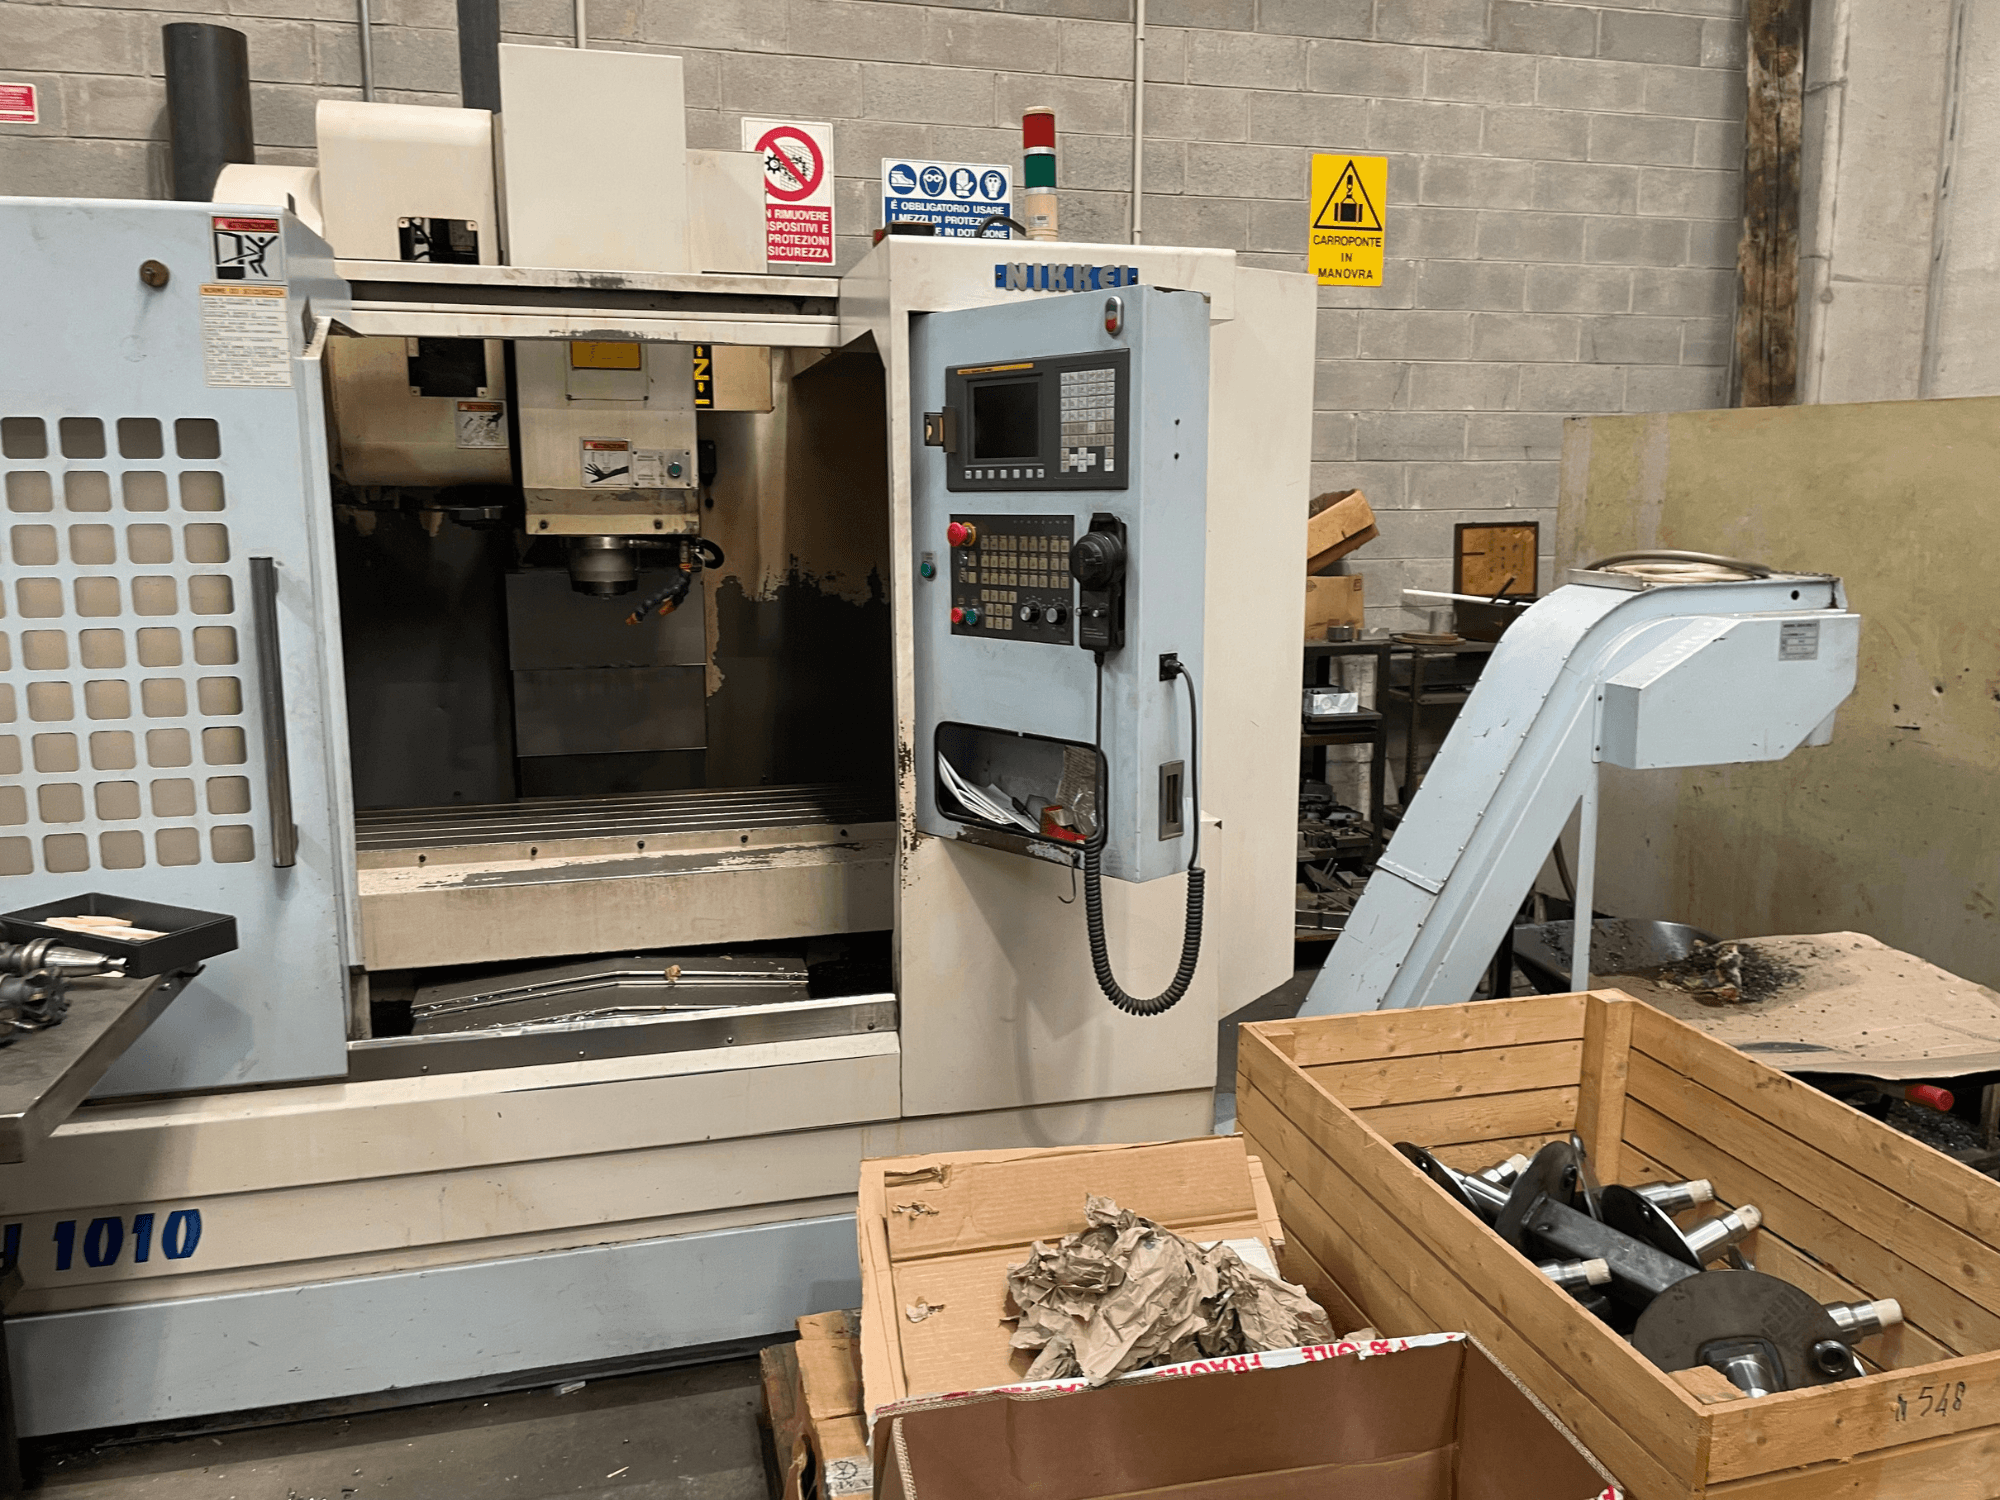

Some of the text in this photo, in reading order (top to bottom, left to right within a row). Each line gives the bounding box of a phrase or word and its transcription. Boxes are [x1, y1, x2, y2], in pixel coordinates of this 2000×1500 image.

[901, 202, 970, 213] OBBLIGATORIO
[973, 205, 1005, 215] USARE
[774, 209, 829, 221] RIMUOVERE
[899, 214, 929, 222] MEZZI
[931, 215, 942, 224] DI
[822, 224, 829, 234] E
[945, 228, 954, 237] IN
[768, 233, 830, 246] PROTEZIONI
[1313, 234, 1382, 248] CARROPONTE
[768, 246, 830, 258] SICUREZZA
[1341, 252, 1353, 262] IN
[1005, 262, 1129, 292] NIKKEI
[1317, 267, 1373, 279] MANOVRA
[52, 1208, 202, 1271] 1010
[1918, 1381, 1966, 1417] 548
